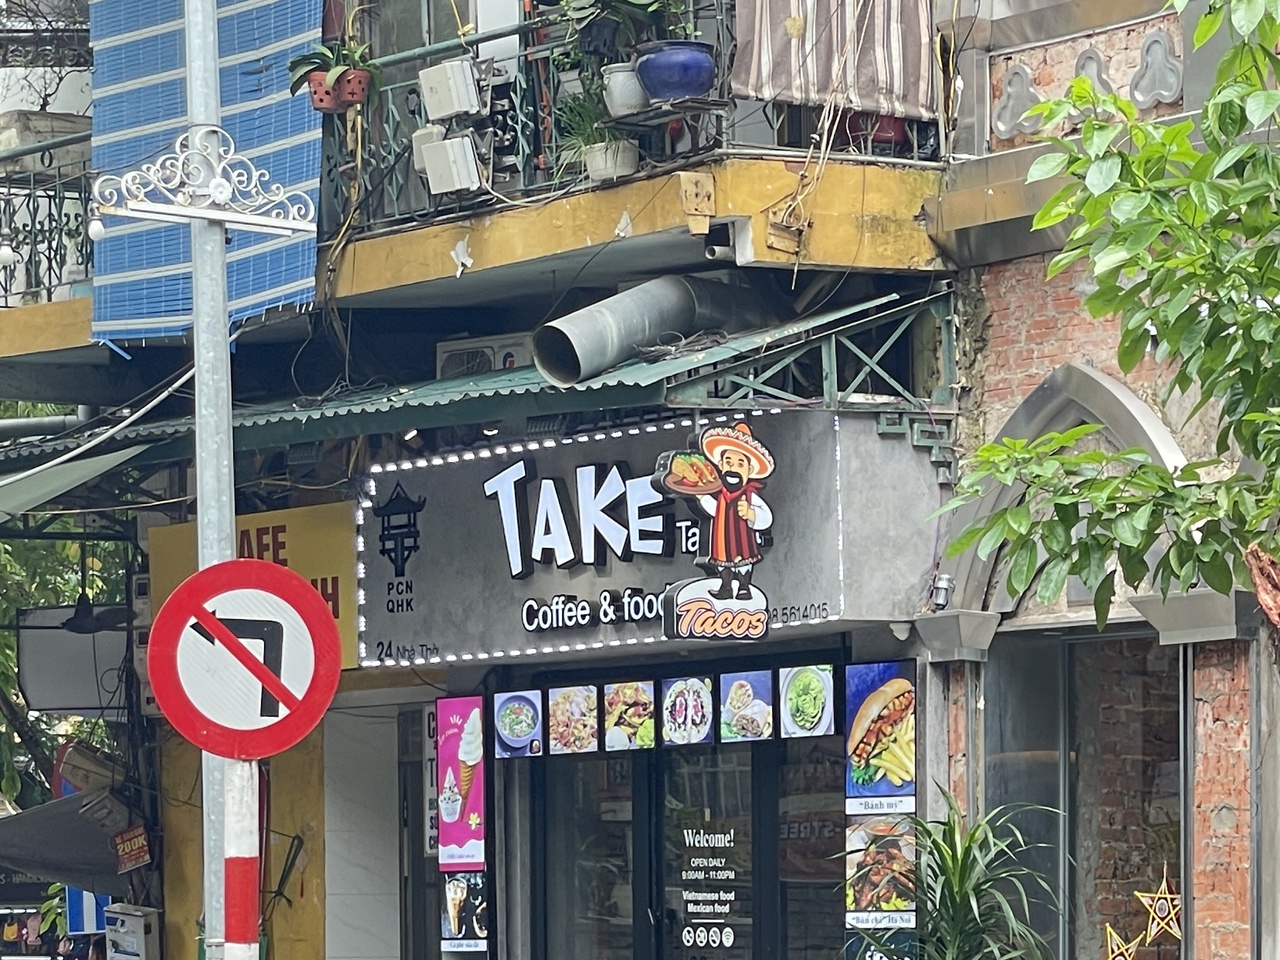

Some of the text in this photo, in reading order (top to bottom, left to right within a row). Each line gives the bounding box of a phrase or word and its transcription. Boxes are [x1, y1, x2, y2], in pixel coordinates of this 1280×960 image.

[483, 460, 665, 577] TAKE
[239, 524, 288, 568] AFE
[387, 580, 413, 596] PCN
[386, 598, 414, 613] QHK
[522, 596, 591, 632] Coffee
[599, 590, 616, 624] &
[781, 602, 829, 623] 5614015
[678, 599, 768, 638] Tacos
[376, 641, 393, 661] 24
[116, 834, 148, 856] 200K
[683, 828, 735, 848] Welcome!
[690, 858, 726, 867] OPEN DAILY
[682, 890, 736, 901] Vietnamese food
[687, 902, 730, 913] Mexican food
